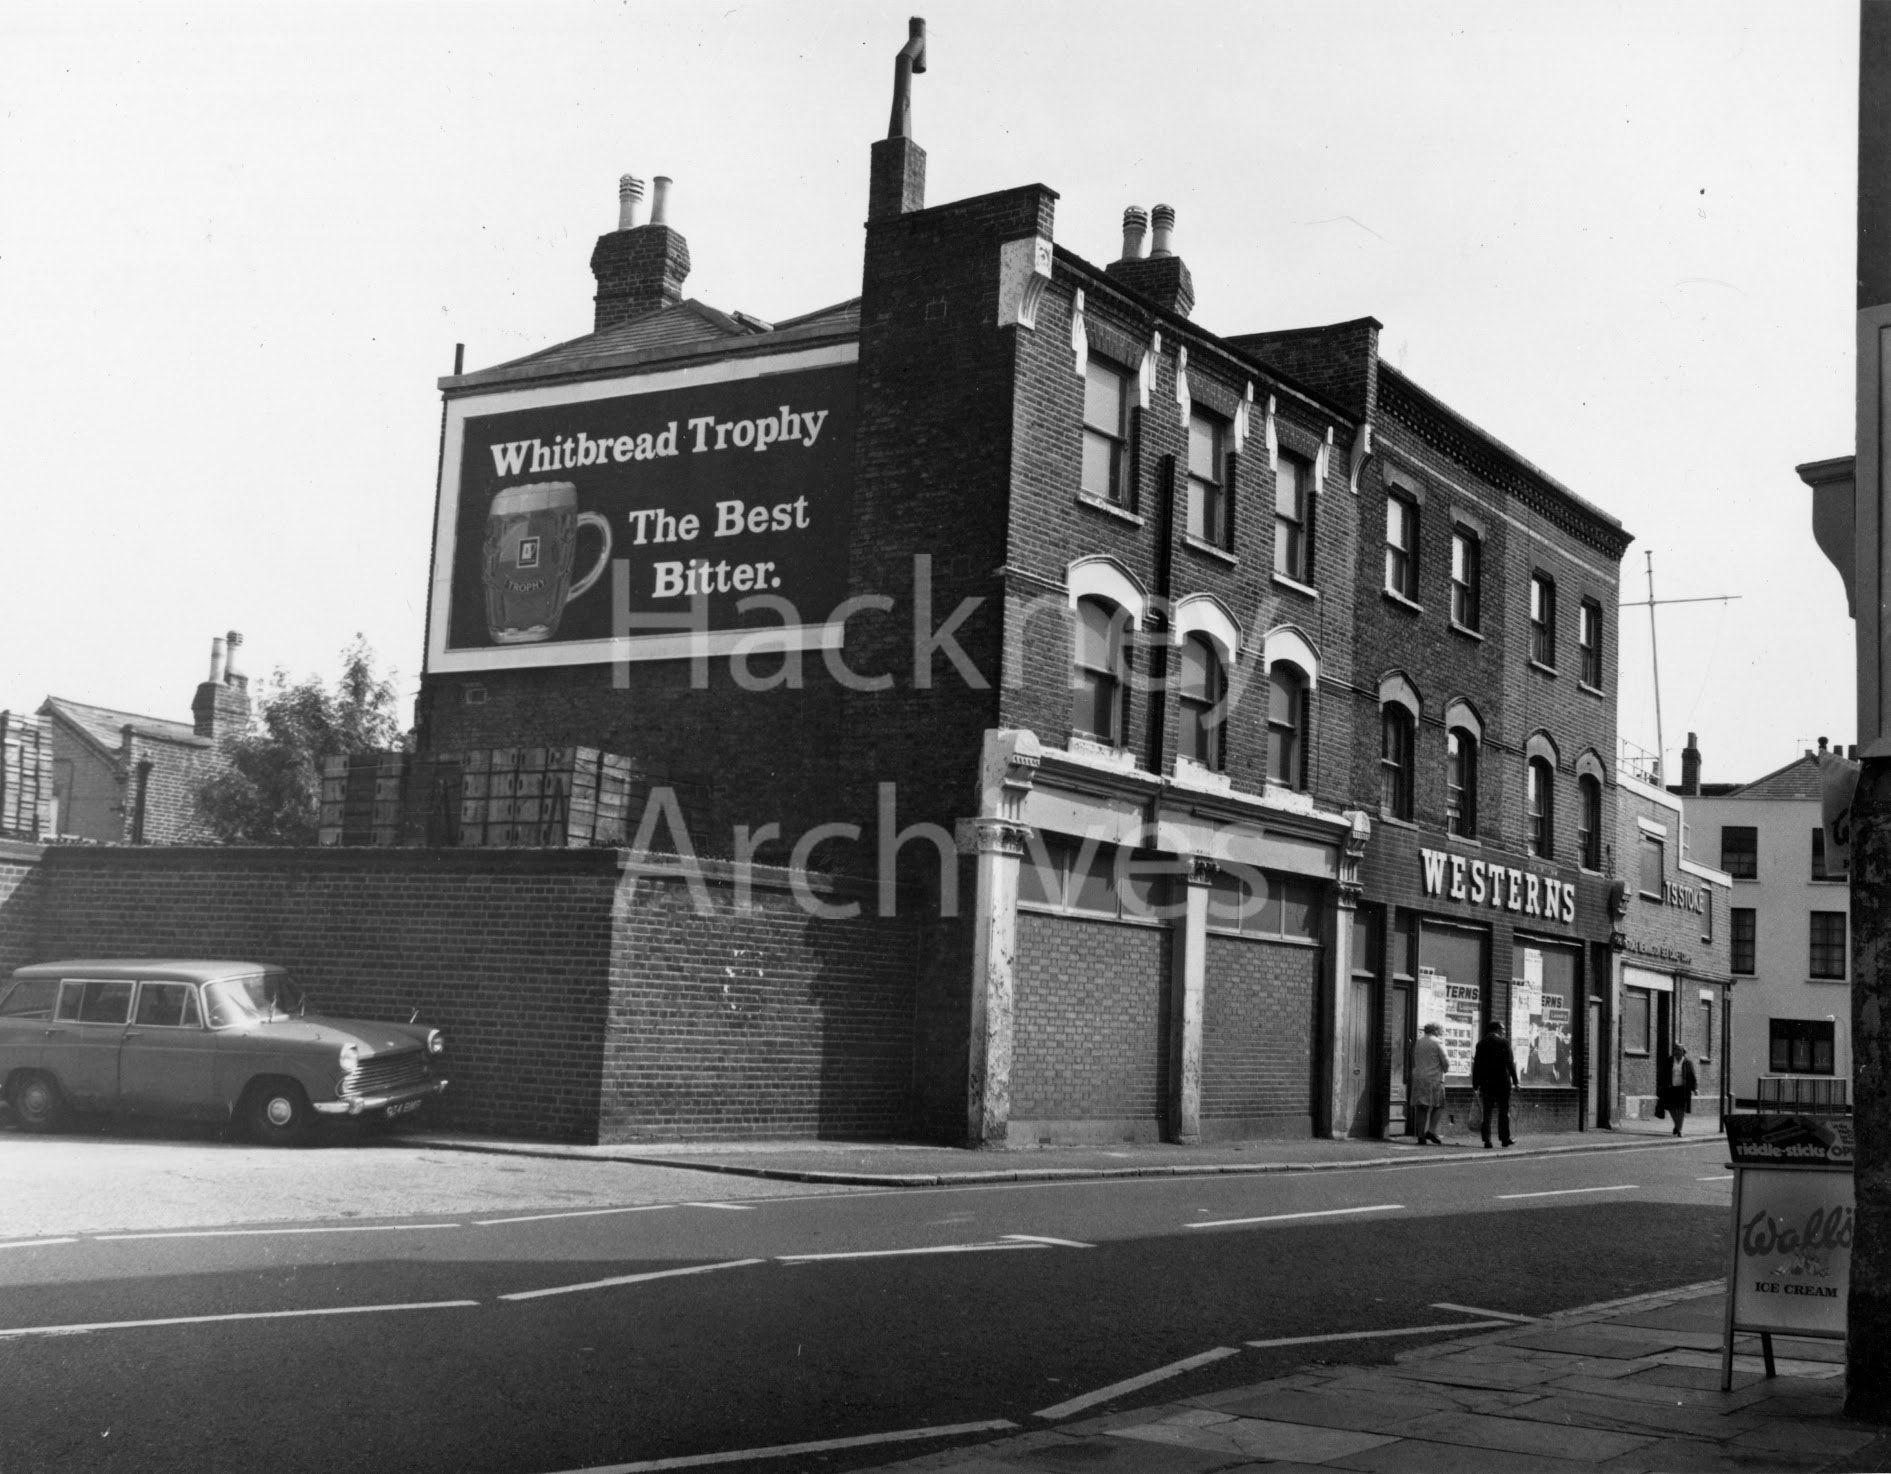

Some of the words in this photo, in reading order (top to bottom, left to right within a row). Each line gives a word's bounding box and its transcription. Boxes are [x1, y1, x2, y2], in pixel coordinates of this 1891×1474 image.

[490, 422, 678, 477] Whitbread
[688, 405, 829, 452] Trophy
[629, 507, 700, 546] The
[714, 495, 810, 538] Best
[508, 576, 546, 593] TROPHY
[651, 559, 781, 599] Bitter.
[1420, 848, 1575, 923] WESTERNS
[1755, 1282, 1780, 1294] ICE
[1784, 1284, 1839, 1298] CREAM
